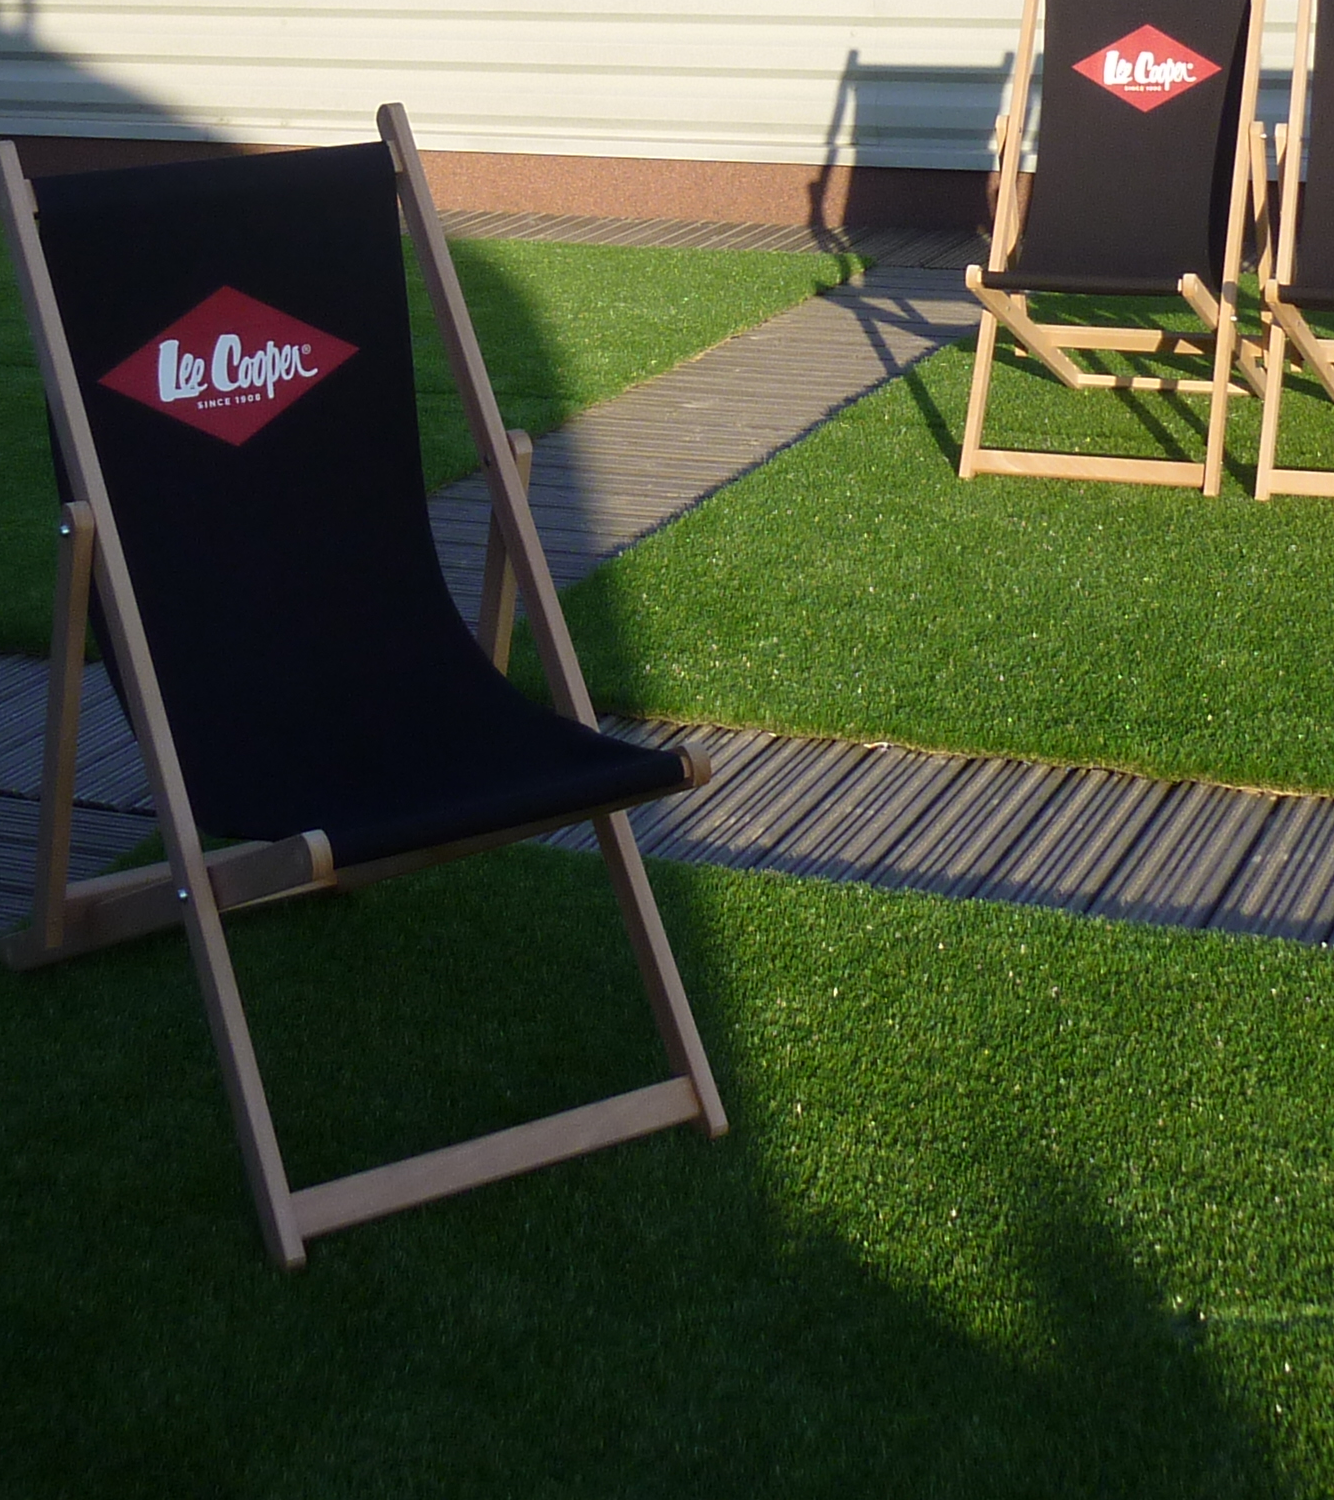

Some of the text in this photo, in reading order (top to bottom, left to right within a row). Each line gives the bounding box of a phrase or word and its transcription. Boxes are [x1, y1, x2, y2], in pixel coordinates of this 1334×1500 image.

[1134, 51, 1197, 91] Cooper
[158, 334, 319, 402] Lee Cooper
[197, 397, 231, 409] SINCE
